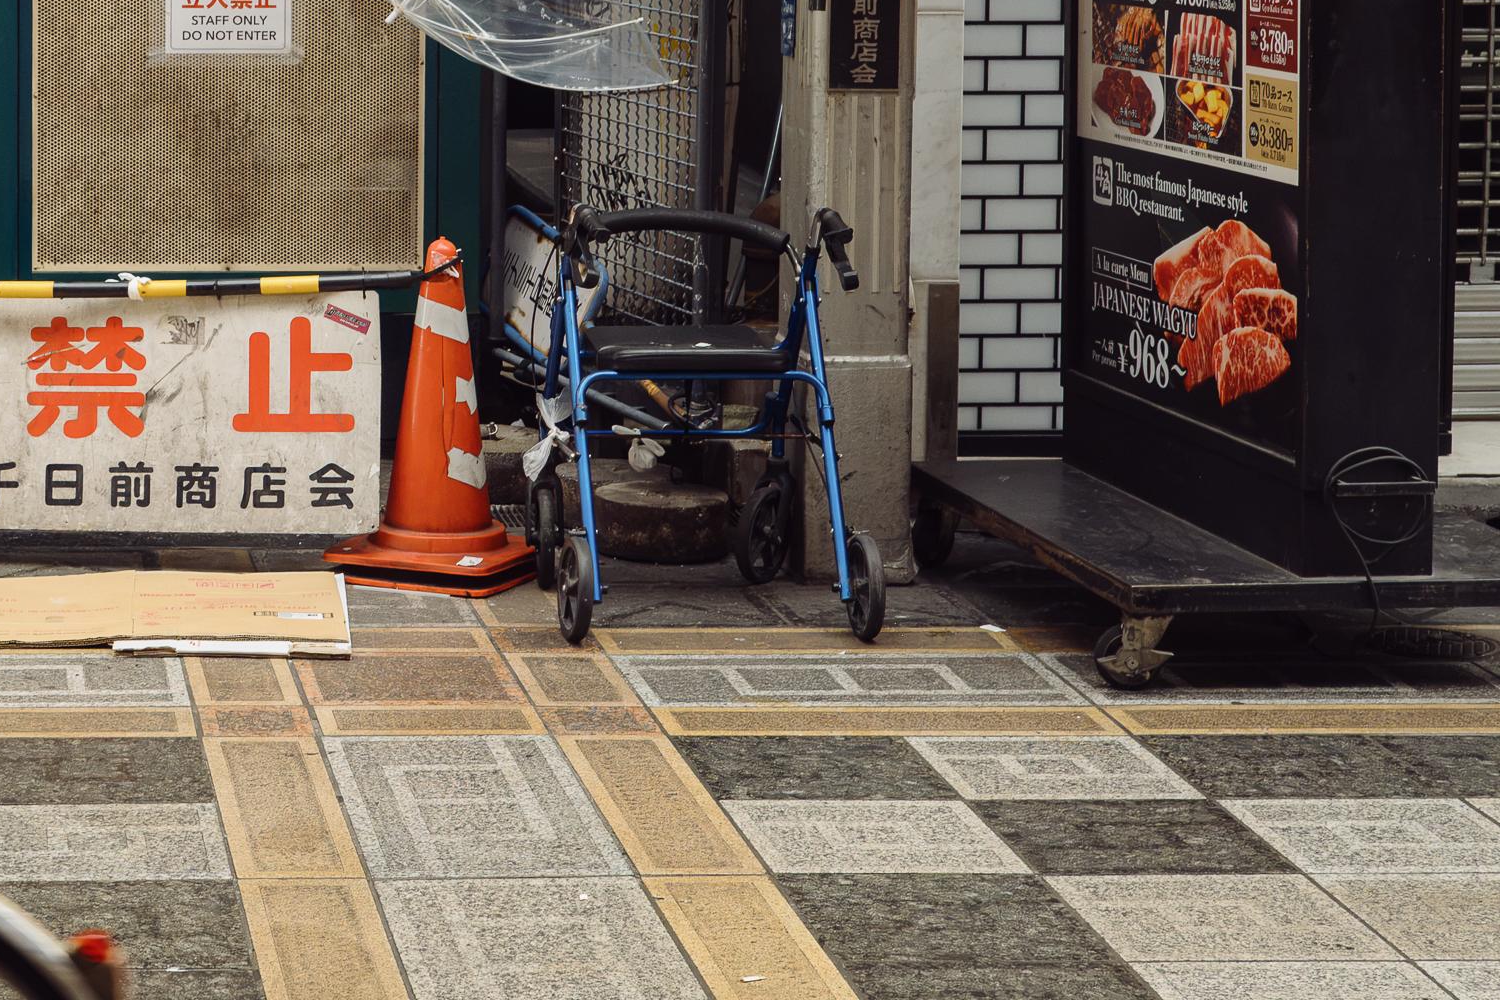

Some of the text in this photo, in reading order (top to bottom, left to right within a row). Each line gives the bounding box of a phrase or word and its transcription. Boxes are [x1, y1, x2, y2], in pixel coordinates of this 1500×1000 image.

[192, 16, 267, 25] STAFF ONLY
[182, 31, 276, 40] DO NOT ENTER
[1260, 29, 1294, 56] 3,780円
[1262, 81, 1293, 103] 70品コース
[1260, 125, 1293, 152] 3,380円
[1116, 162, 1248, 217] The most famous Japanese style
[1116, 187, 1184, 222] BBQ restaurant.
[1103, 256, 1110, 268] la
[1111, 261, 1128, 275] carte
[1130, 265, 1149, 284] Menu
[1092, 282, 1197, 339] JAPANESE WAGYU
